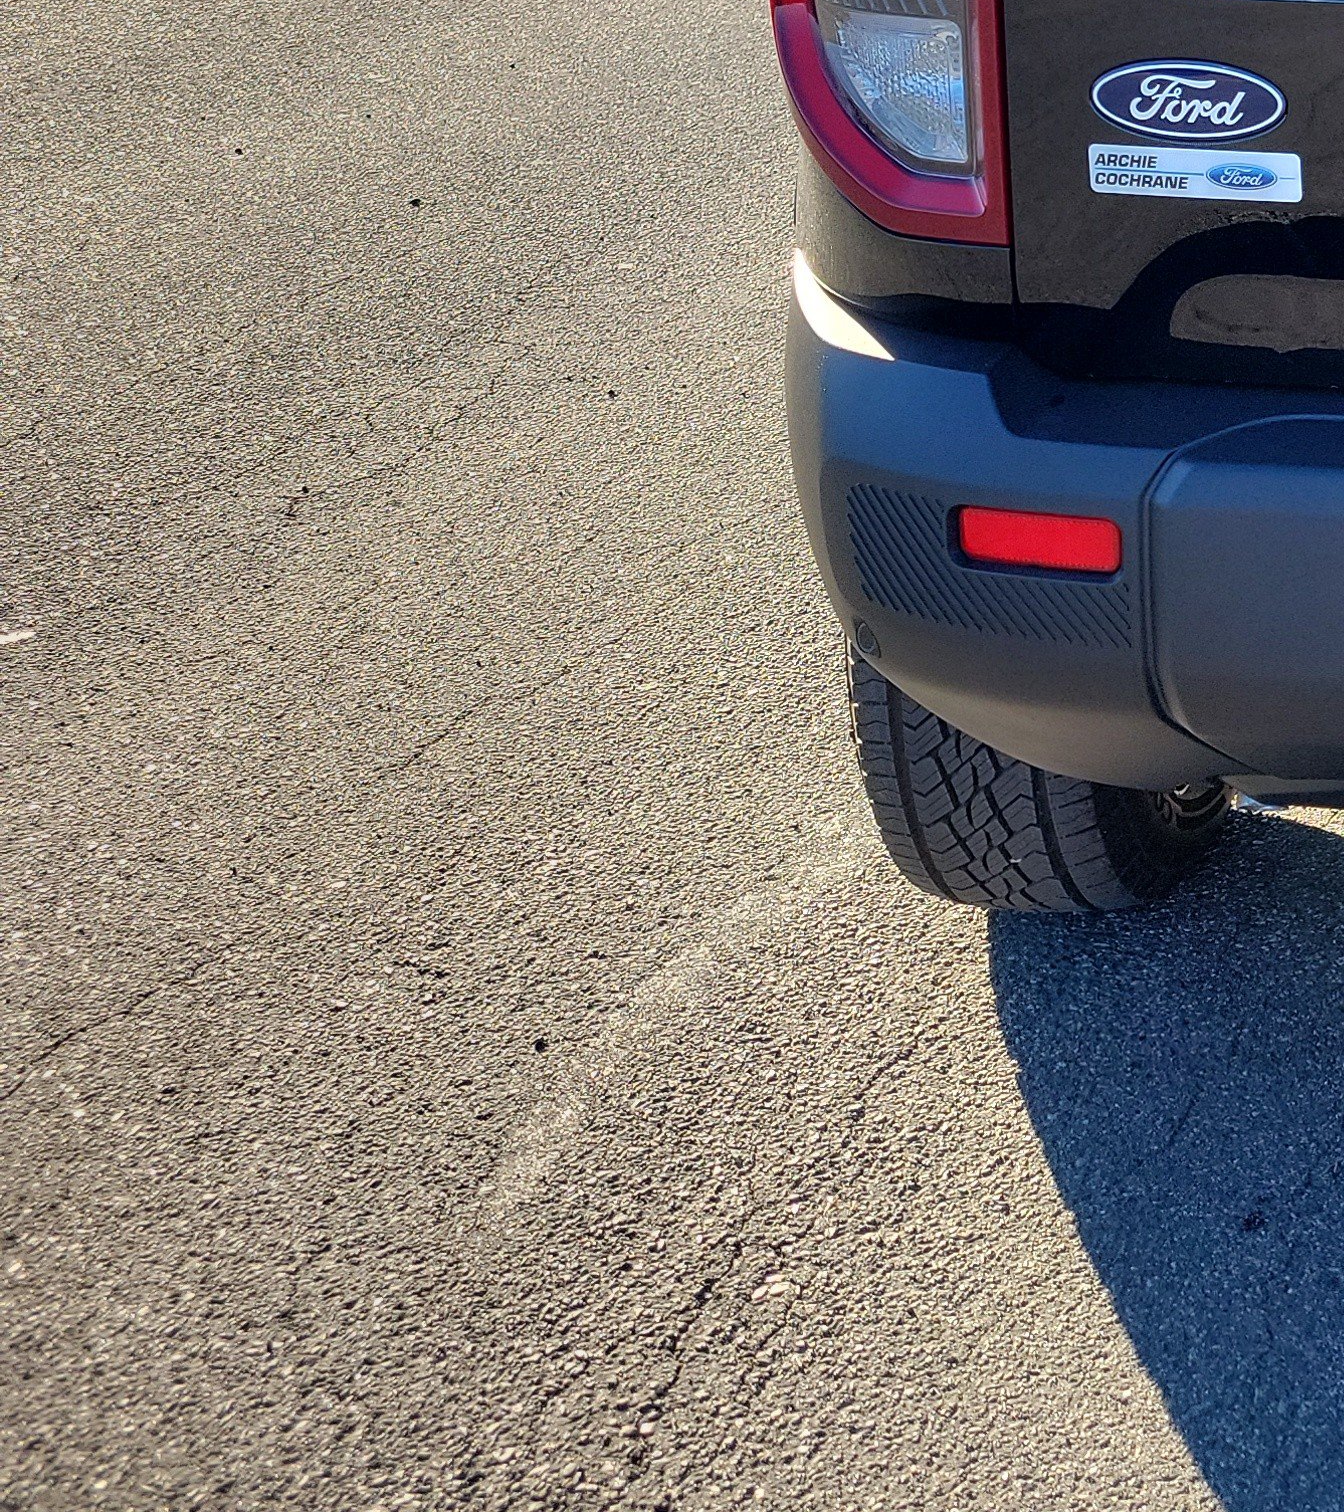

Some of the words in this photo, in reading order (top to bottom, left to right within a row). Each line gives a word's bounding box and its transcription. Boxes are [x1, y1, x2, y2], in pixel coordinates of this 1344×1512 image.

[1129, 74, 1246, 126] Ford
[1095, 153, 1158, 169] ARCHIE
[1095, 172, 1189, 190] COCHRANE
[1220, 167, 1262, 187] Ford
